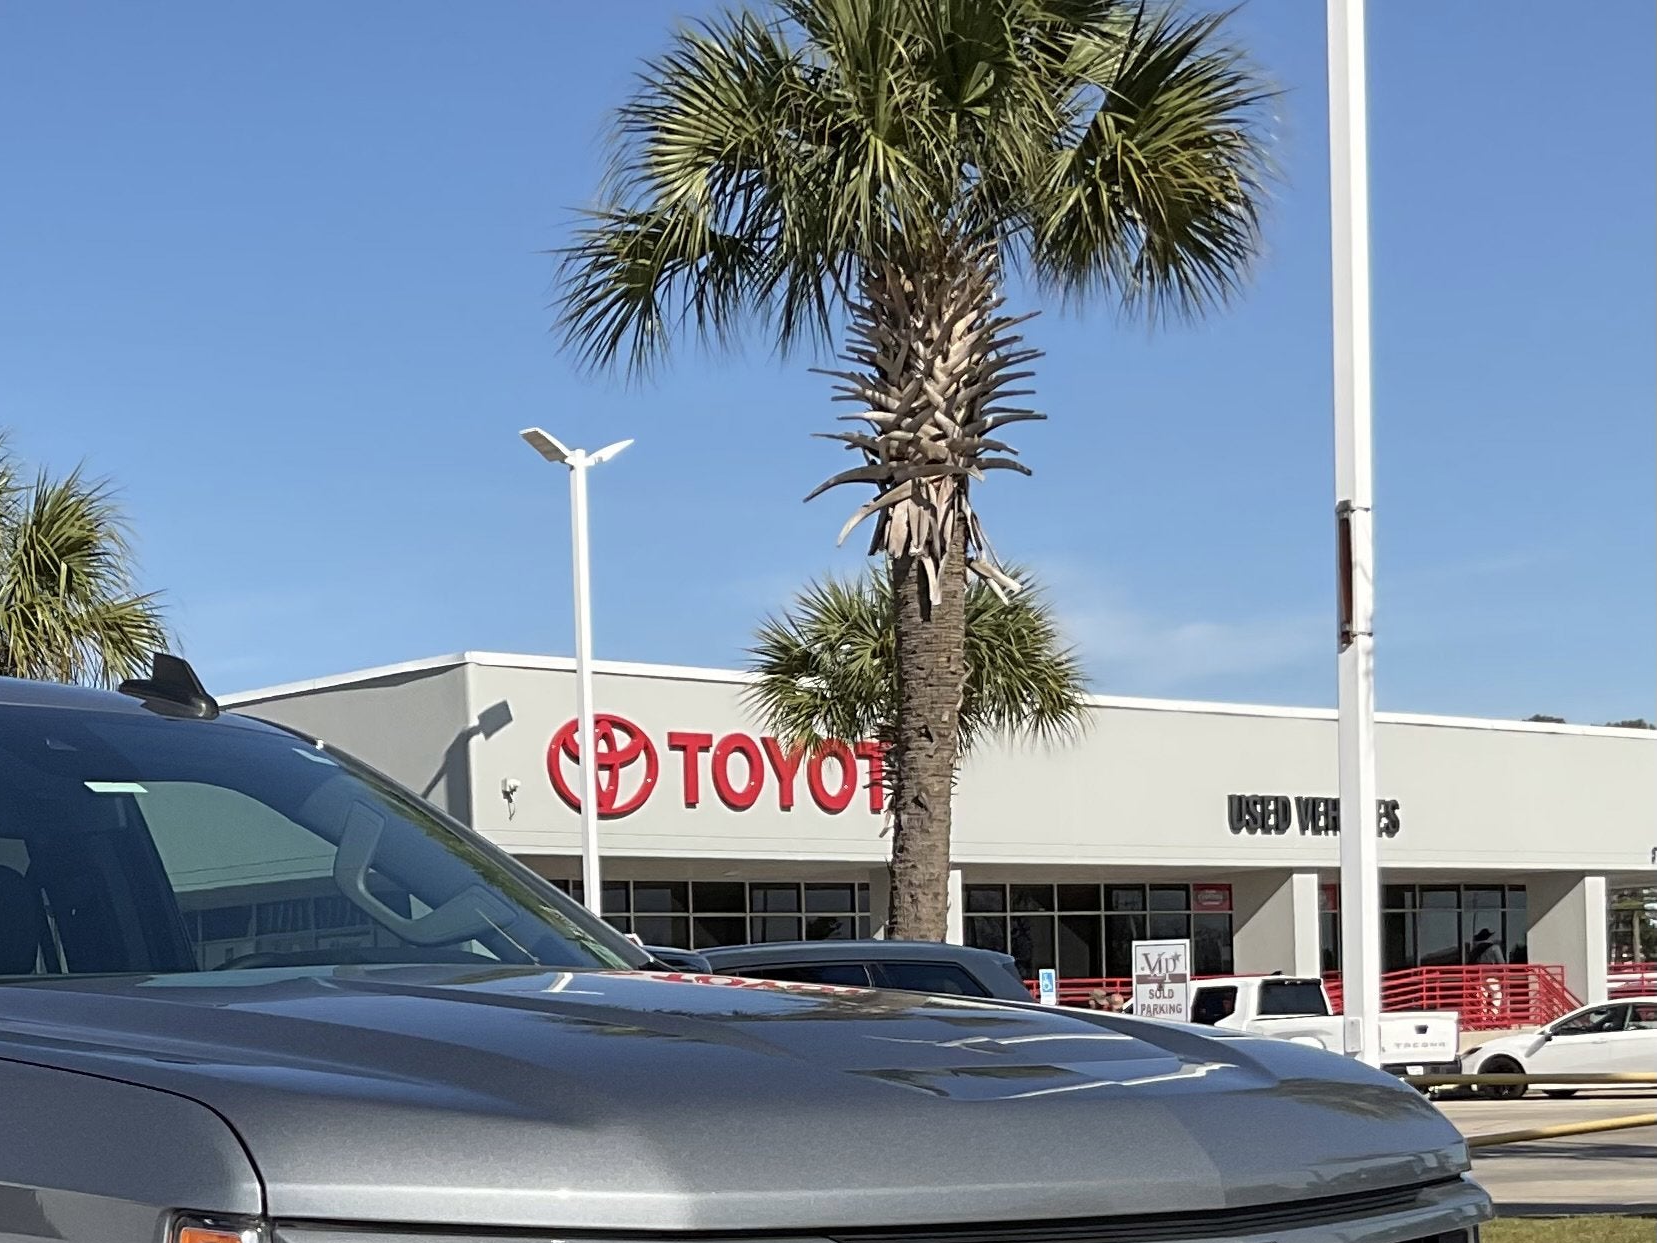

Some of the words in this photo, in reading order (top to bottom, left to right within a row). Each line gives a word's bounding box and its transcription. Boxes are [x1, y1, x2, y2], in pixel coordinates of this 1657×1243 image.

[667, 731, 893, 816] TOYOT
[1227, 794, 1291, 835] USED
[1294, 796, 1400, 838] VEHES
[1148, 988, 1175, 1000] SOLD
[1140, 1003, 1183, 1017] PARKING
